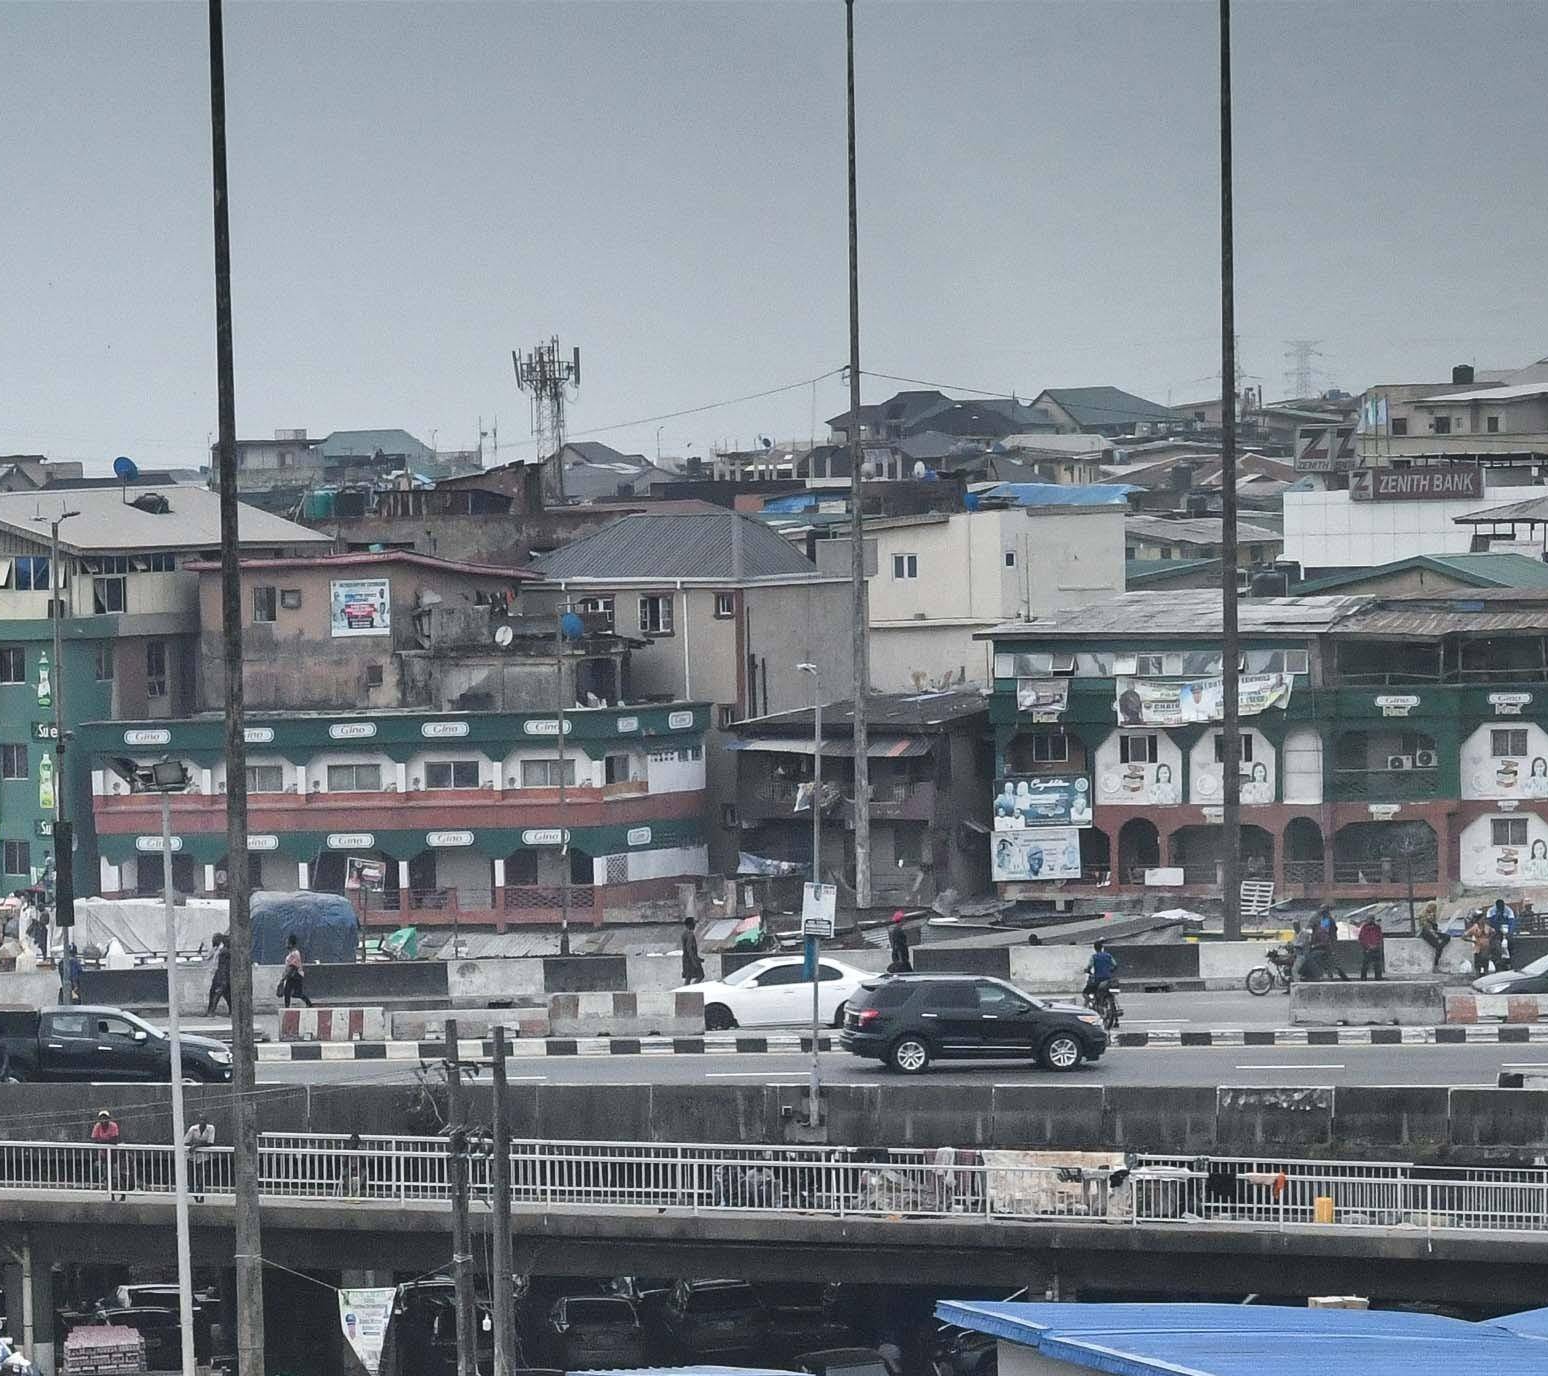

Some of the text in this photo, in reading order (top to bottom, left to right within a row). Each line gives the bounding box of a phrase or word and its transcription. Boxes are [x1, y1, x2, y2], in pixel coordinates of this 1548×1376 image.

[1379, 472, 1474, 493] ZENITH BANK
[340, 724, 366, 735] Gino
[432, 723, 459, 734] Gino
